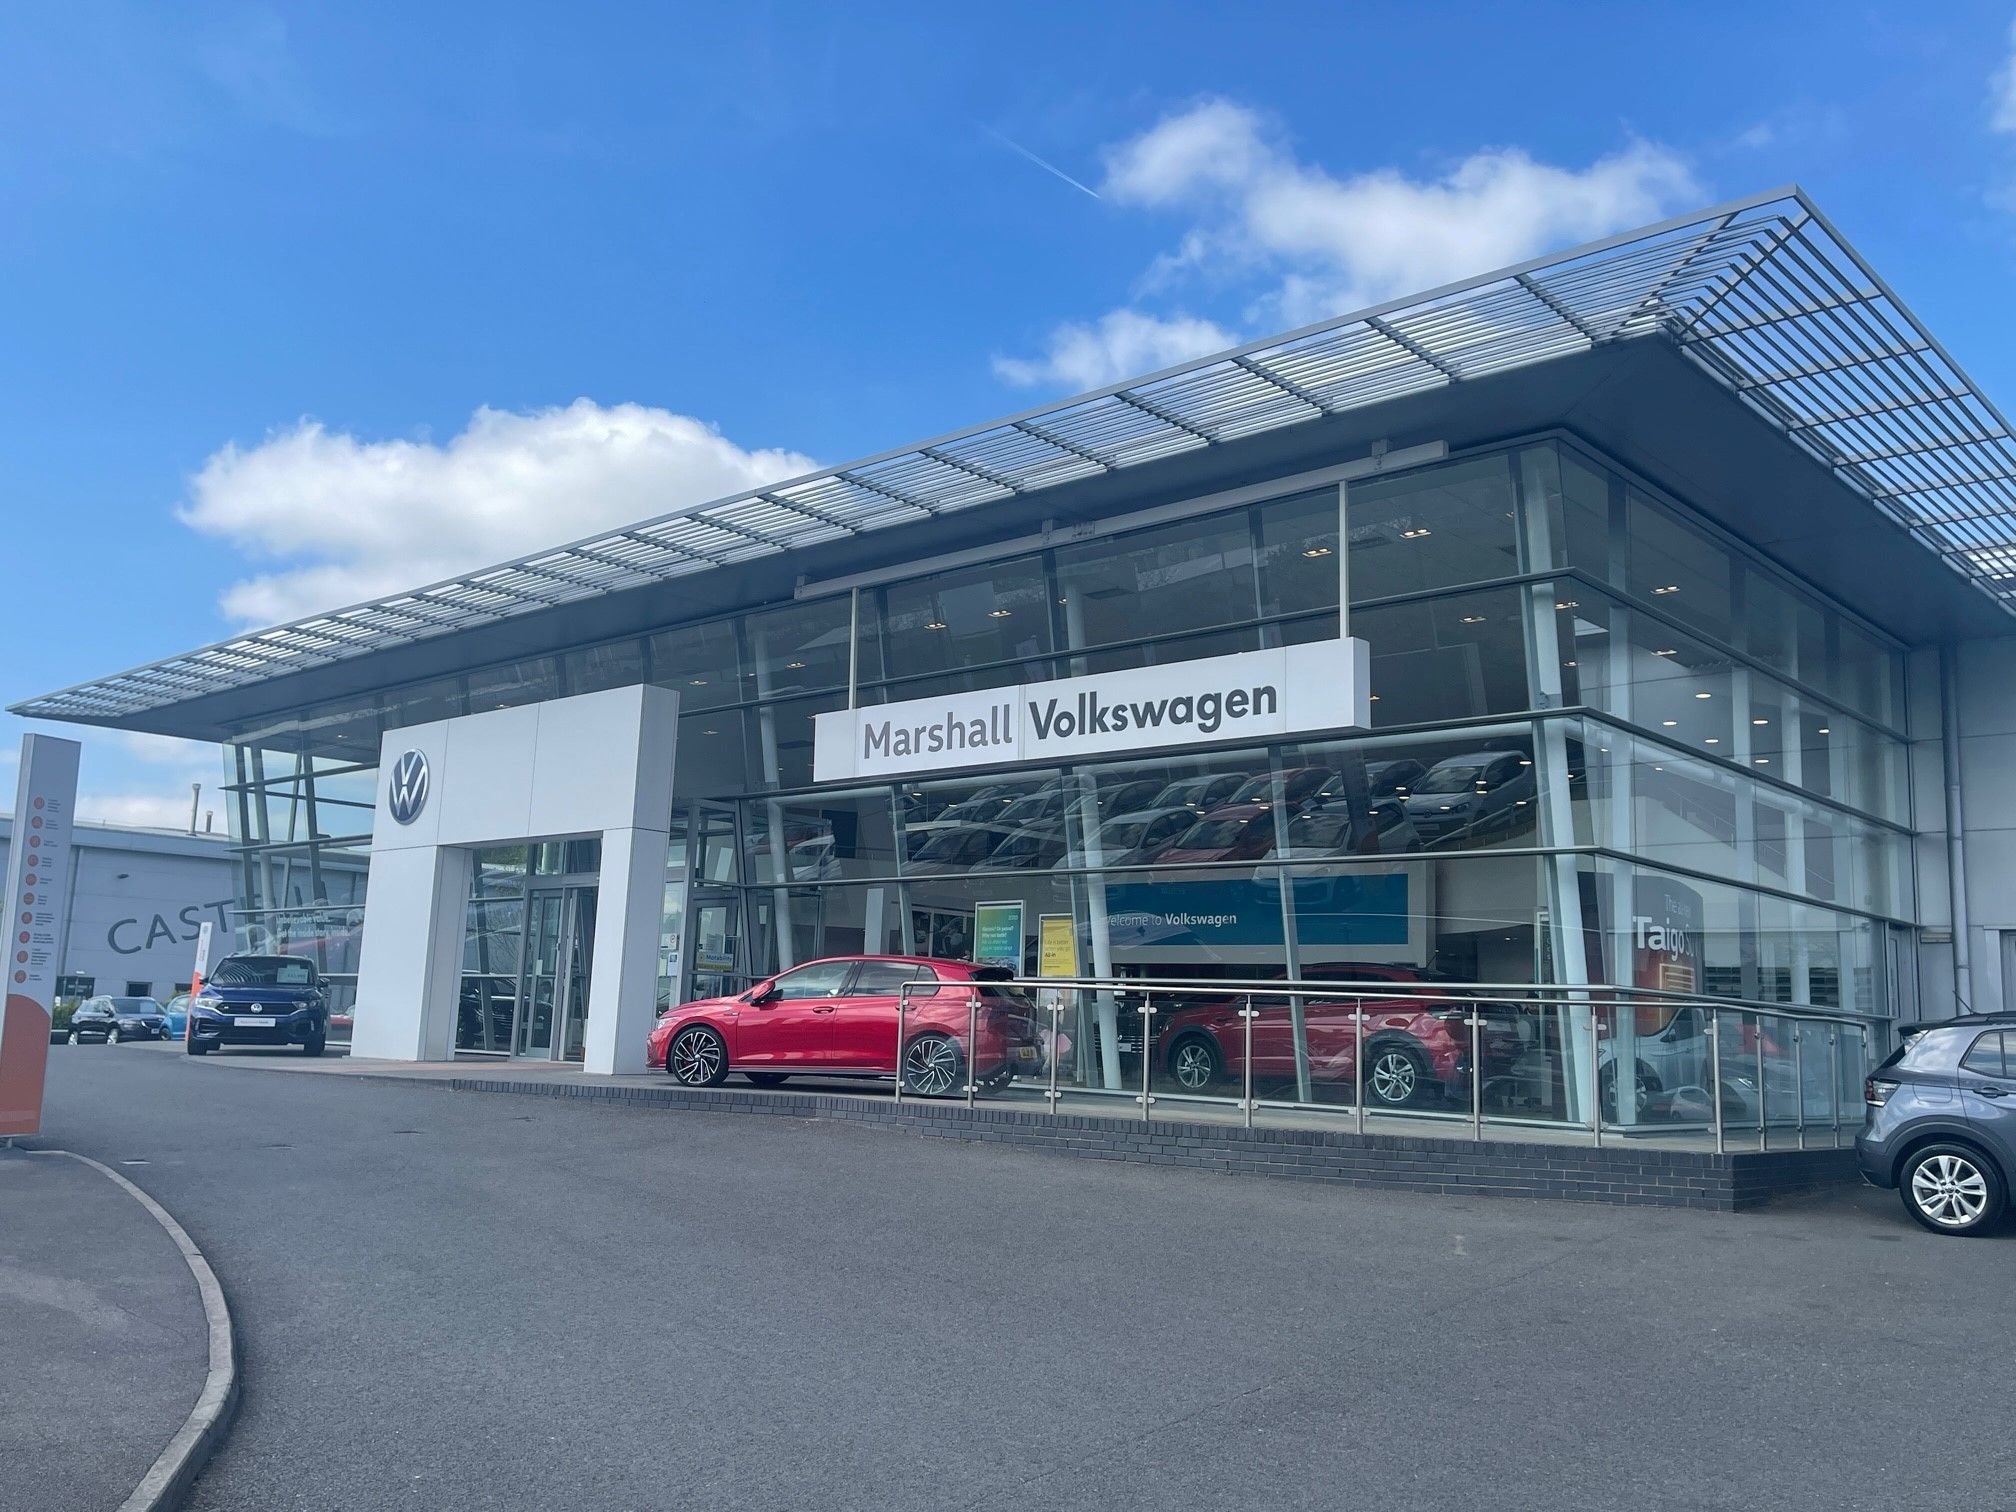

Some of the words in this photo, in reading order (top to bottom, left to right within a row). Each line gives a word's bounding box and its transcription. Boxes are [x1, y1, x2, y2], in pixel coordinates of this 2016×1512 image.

[864, 705, 1013, 759] Marshall
[1028, 684, 1278, 741] Volkswagen
[1164, 912, 1238, 928] Volkswagen
[1632, 915, 1685, 962] Taigo
